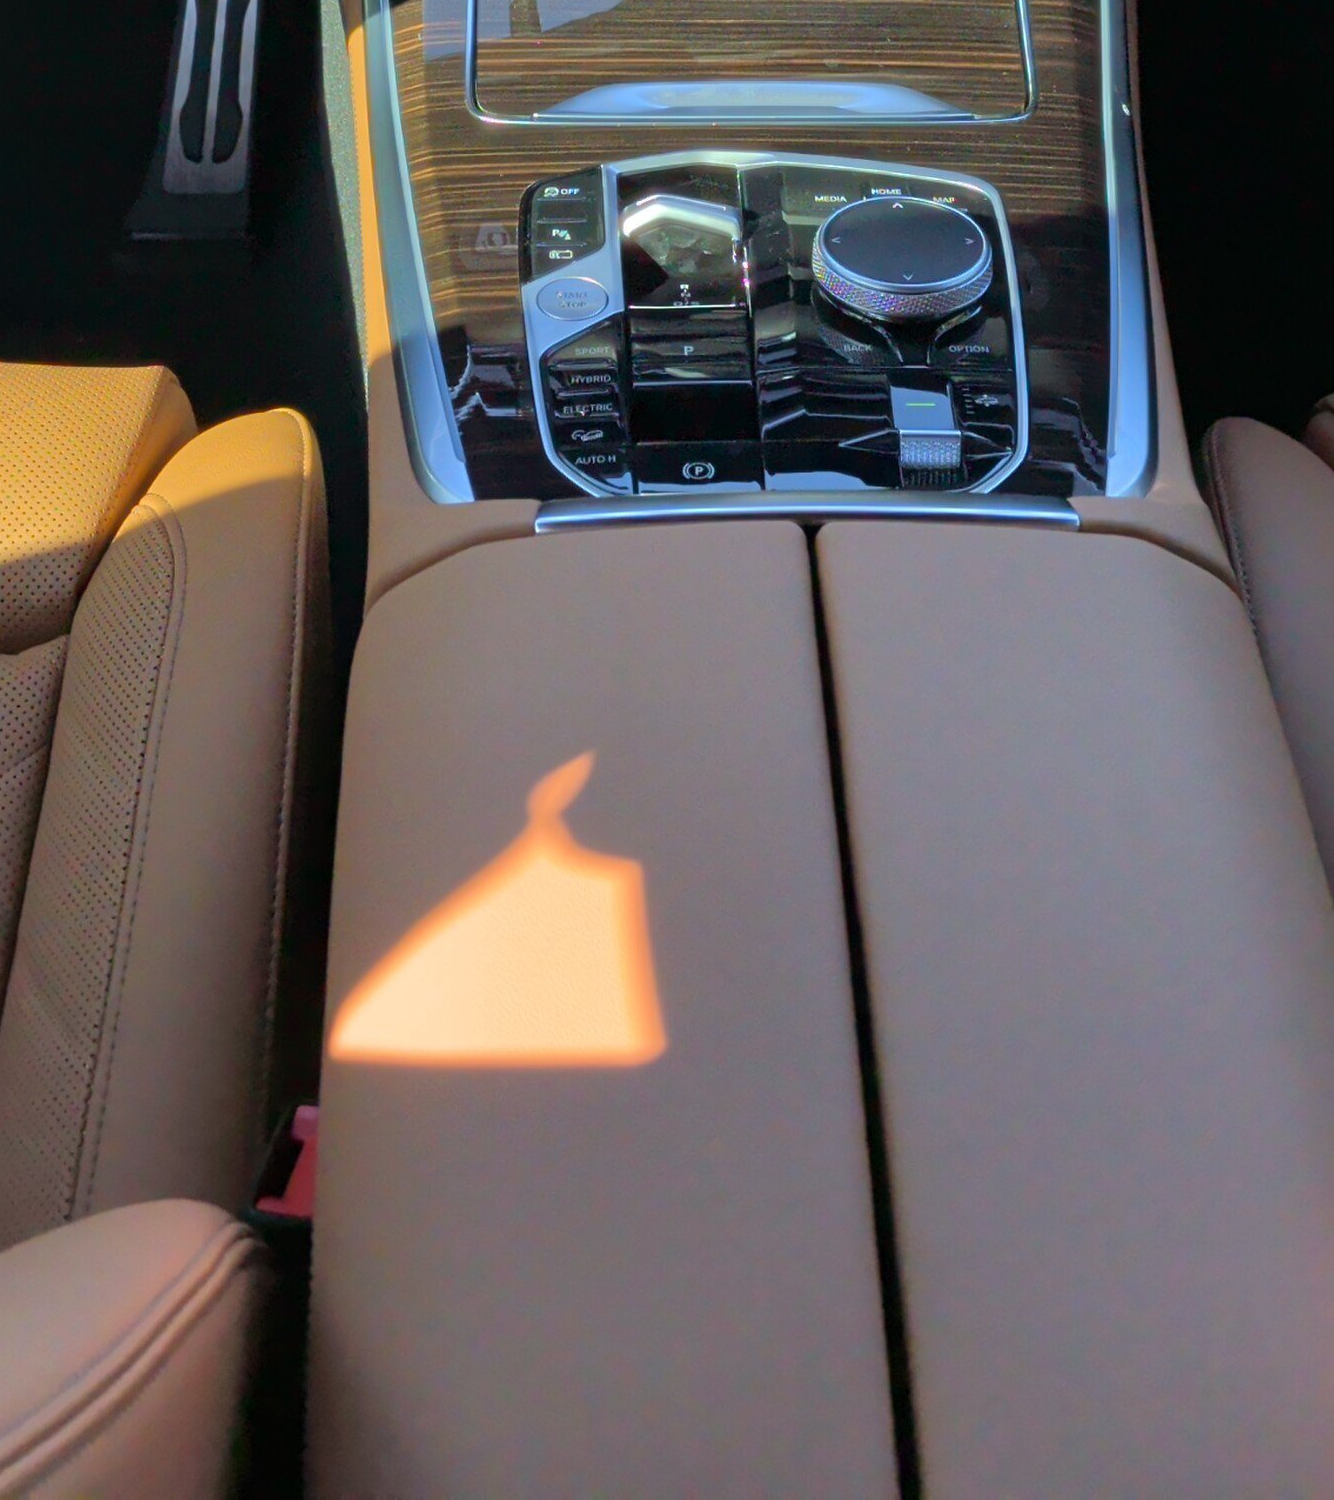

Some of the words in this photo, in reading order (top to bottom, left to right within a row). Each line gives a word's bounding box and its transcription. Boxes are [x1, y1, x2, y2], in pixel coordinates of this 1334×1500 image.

[560, 188, 580, 196] OFF
[870, 187, 903, 196] HOME
[814, 195, 848, 203] MEDIA
[575, 346, 611, 357] SPORT
[683, 345, 695, 357] P
[843, 343, 873, 352] BACK
[948, 344, 990, 353] OPTION
[570, 374, 612, 385] HYBRID
[563, 403, 614, 415] ELECTRIC
[575, 455, 606, 466] AUTO
[607, 454, 617, 464] H
